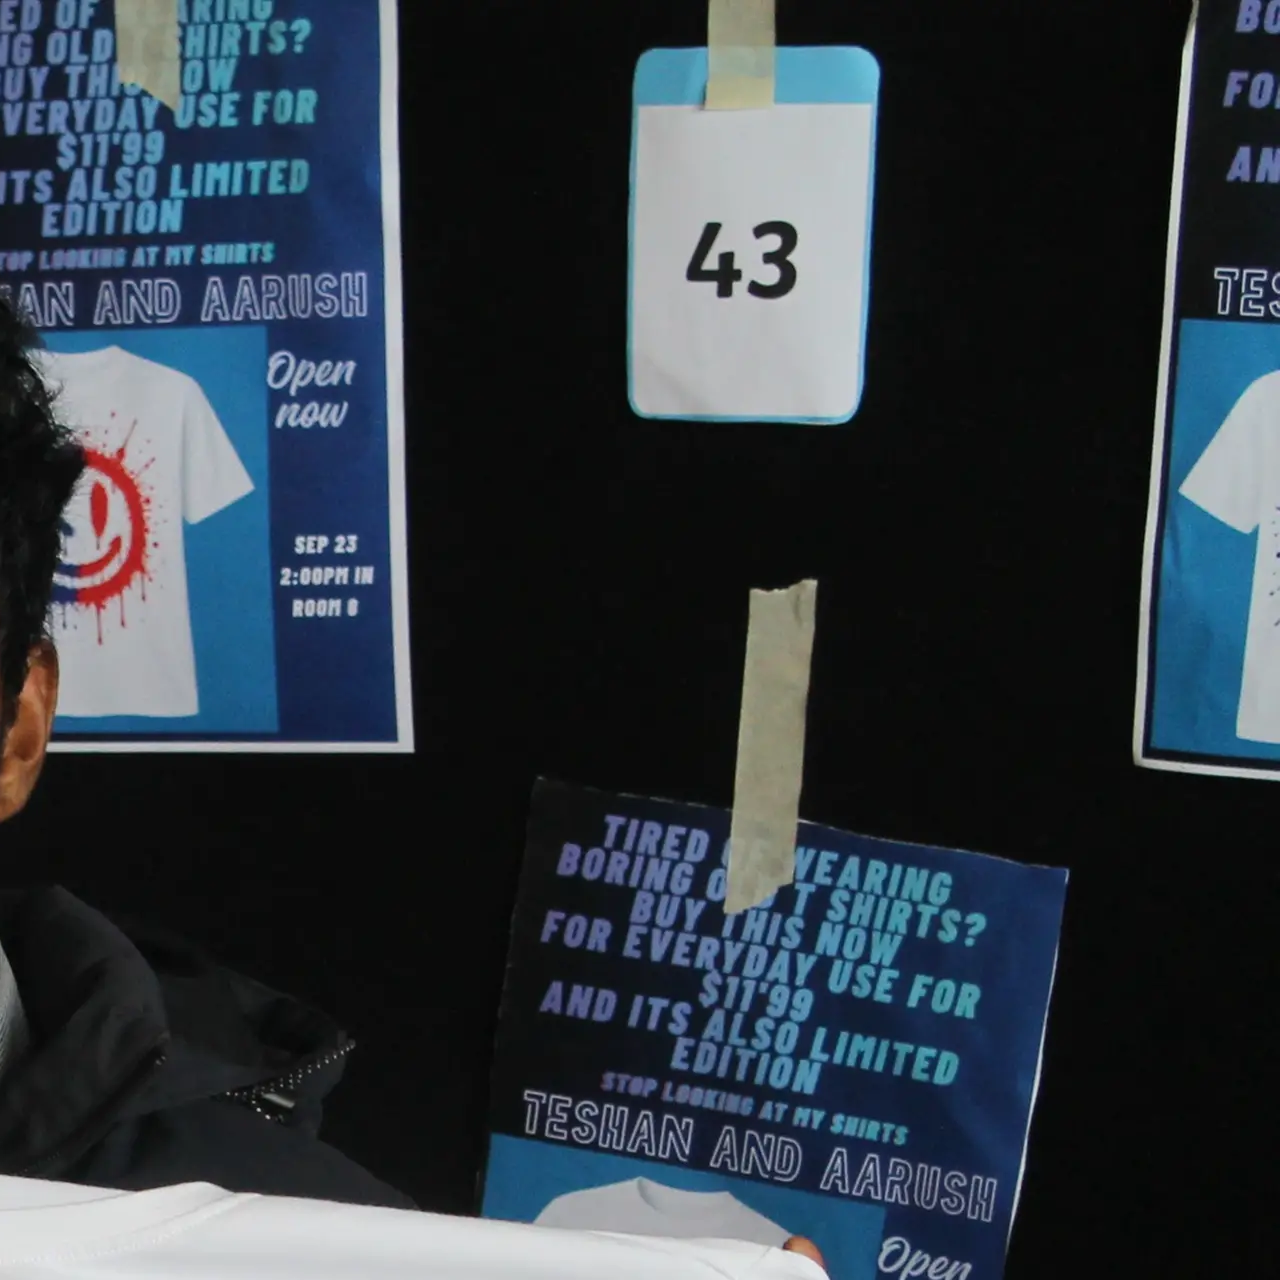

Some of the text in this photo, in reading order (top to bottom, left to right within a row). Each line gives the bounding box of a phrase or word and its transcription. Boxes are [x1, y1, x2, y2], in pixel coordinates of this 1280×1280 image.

[55, 0, 98, 29] OF
[46, 28, 113, 64] OLD
[183, 58, 237, 93] OW
[173, 92, 240, 129] USE
[252, 89, 318, 126] FOR
[66, 165, 157, 202] ALSO
[169, 158, 310, 198] LIMITED
[41, 199, 184, 238] EDITION
[40, 248, 127, 270] LOOKING
[132, 246, 160, 267] AT
[165, 244, 195, 266] MY
[201, 241, 275, 265] SHIRTS
[686, 220, 798, 299] 43
[93, 278, 182, 324] AND
[200, 271, 368, 322] AARUSH
[267, 350, 357, 396] Open
[275, 401, 349, 428] now
[294, 534, 358, 555] SEP 23
[280, 566, 374, 586] 2:00PM IN
[292, 598, 342, 617] ROOM
[603, 814, 710, 863] TIRED
[556, 842, 694, 896] BORING
[793, 882, 817, 917] T
[826, 889, 987, 947] SHIRTS?
[630, 890, 706, 931] BUY
[815, 922, 904, 967] NOW
[540, 910, 981, 1019] FOR EVERYDAY USE FOR
[540, 980, 960, 1085] AND ITS ALSO LIMITED
[670, 1037, 822, 1094] EDITION
[600, 1071, 909, 1146] STOP LOOKING AT MY SHIRTS
[524, 1089, 997, 1222] TESHAN AND AARUSH
